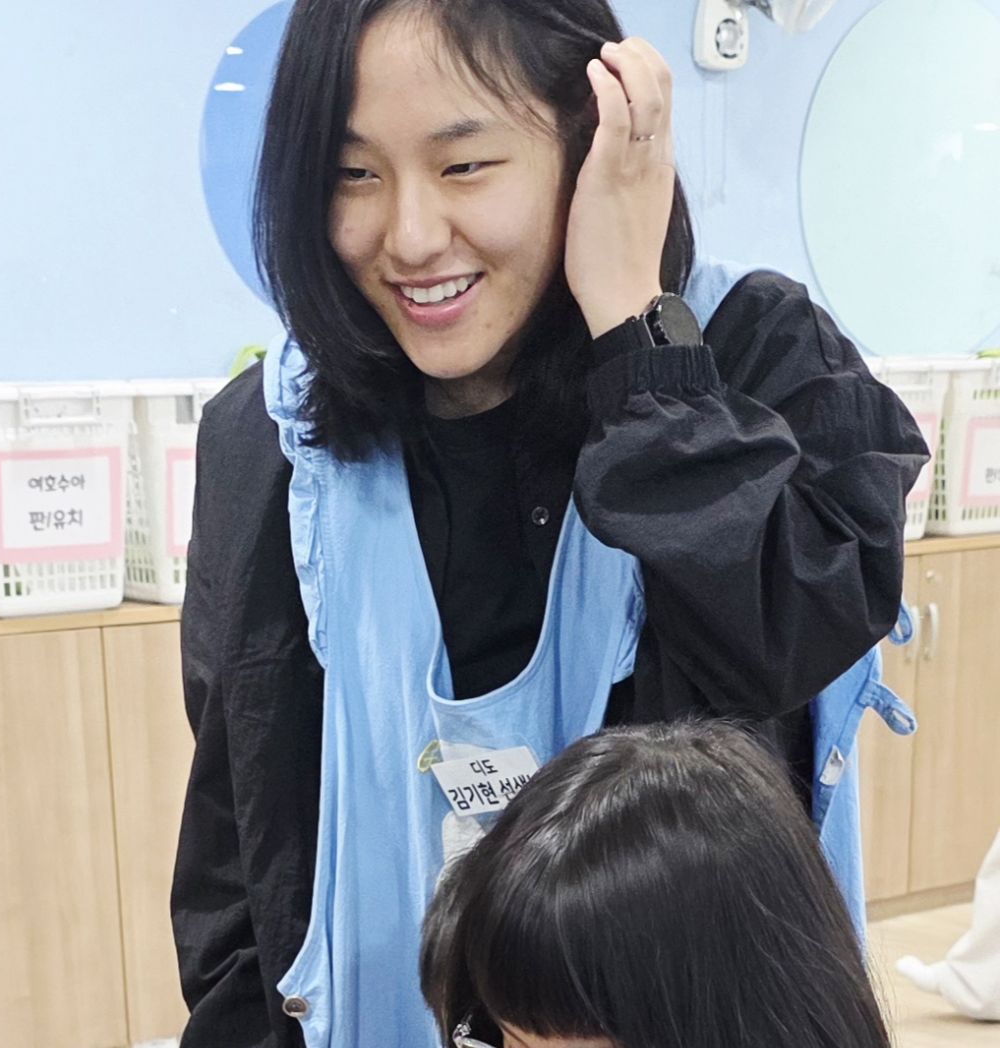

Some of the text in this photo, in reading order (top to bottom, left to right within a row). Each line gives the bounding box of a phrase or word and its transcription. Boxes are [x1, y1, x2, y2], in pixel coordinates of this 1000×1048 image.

[28, 475, 86, 493] 여호수아
[29, 508, 83, 532] 판/유치
[470, 759, 498, 776] 디도
[448, 781, 500, 810] 김기현
